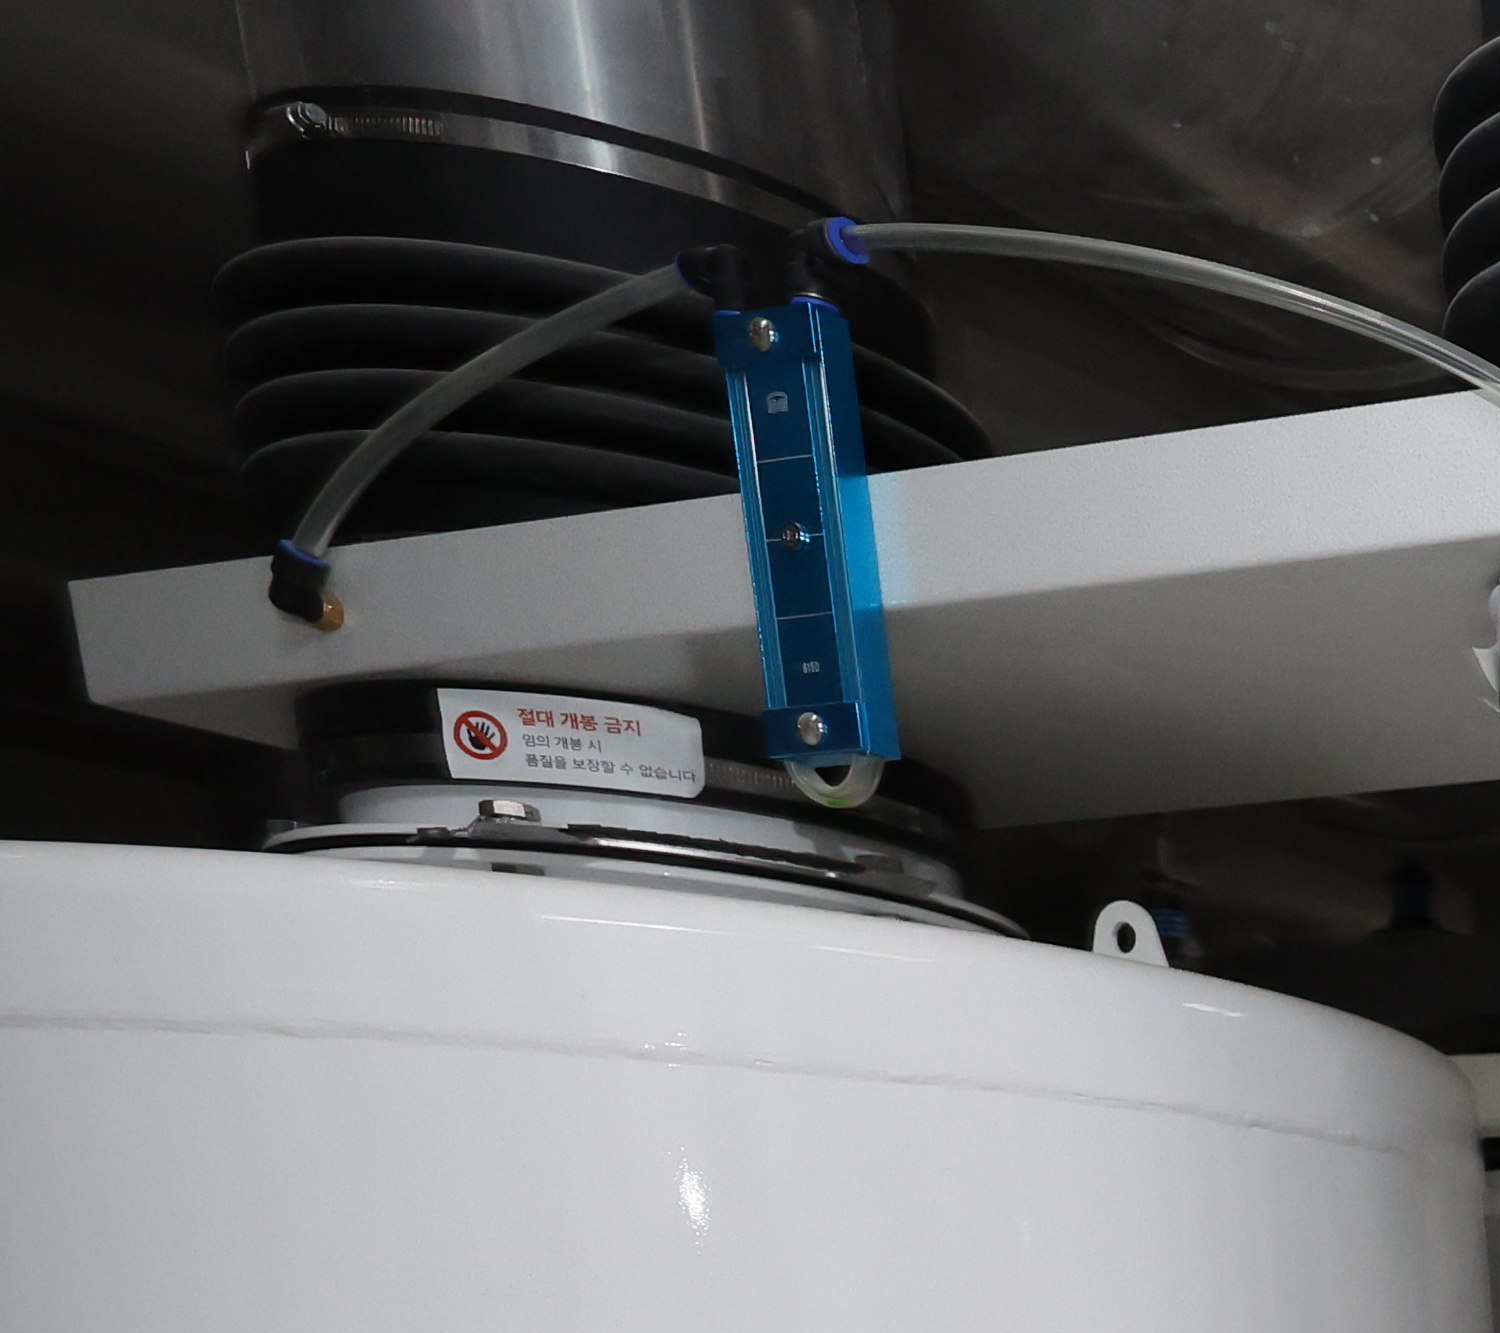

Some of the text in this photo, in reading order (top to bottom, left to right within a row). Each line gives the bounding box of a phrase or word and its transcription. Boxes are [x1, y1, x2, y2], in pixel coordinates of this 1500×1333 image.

[517, 707, 642, 737] 절대 개봉 금지
[522, 734, 602, 753] 임의 개봉 시
[525, 753, 697, 784] 품질을 보장할 수 없습니다
